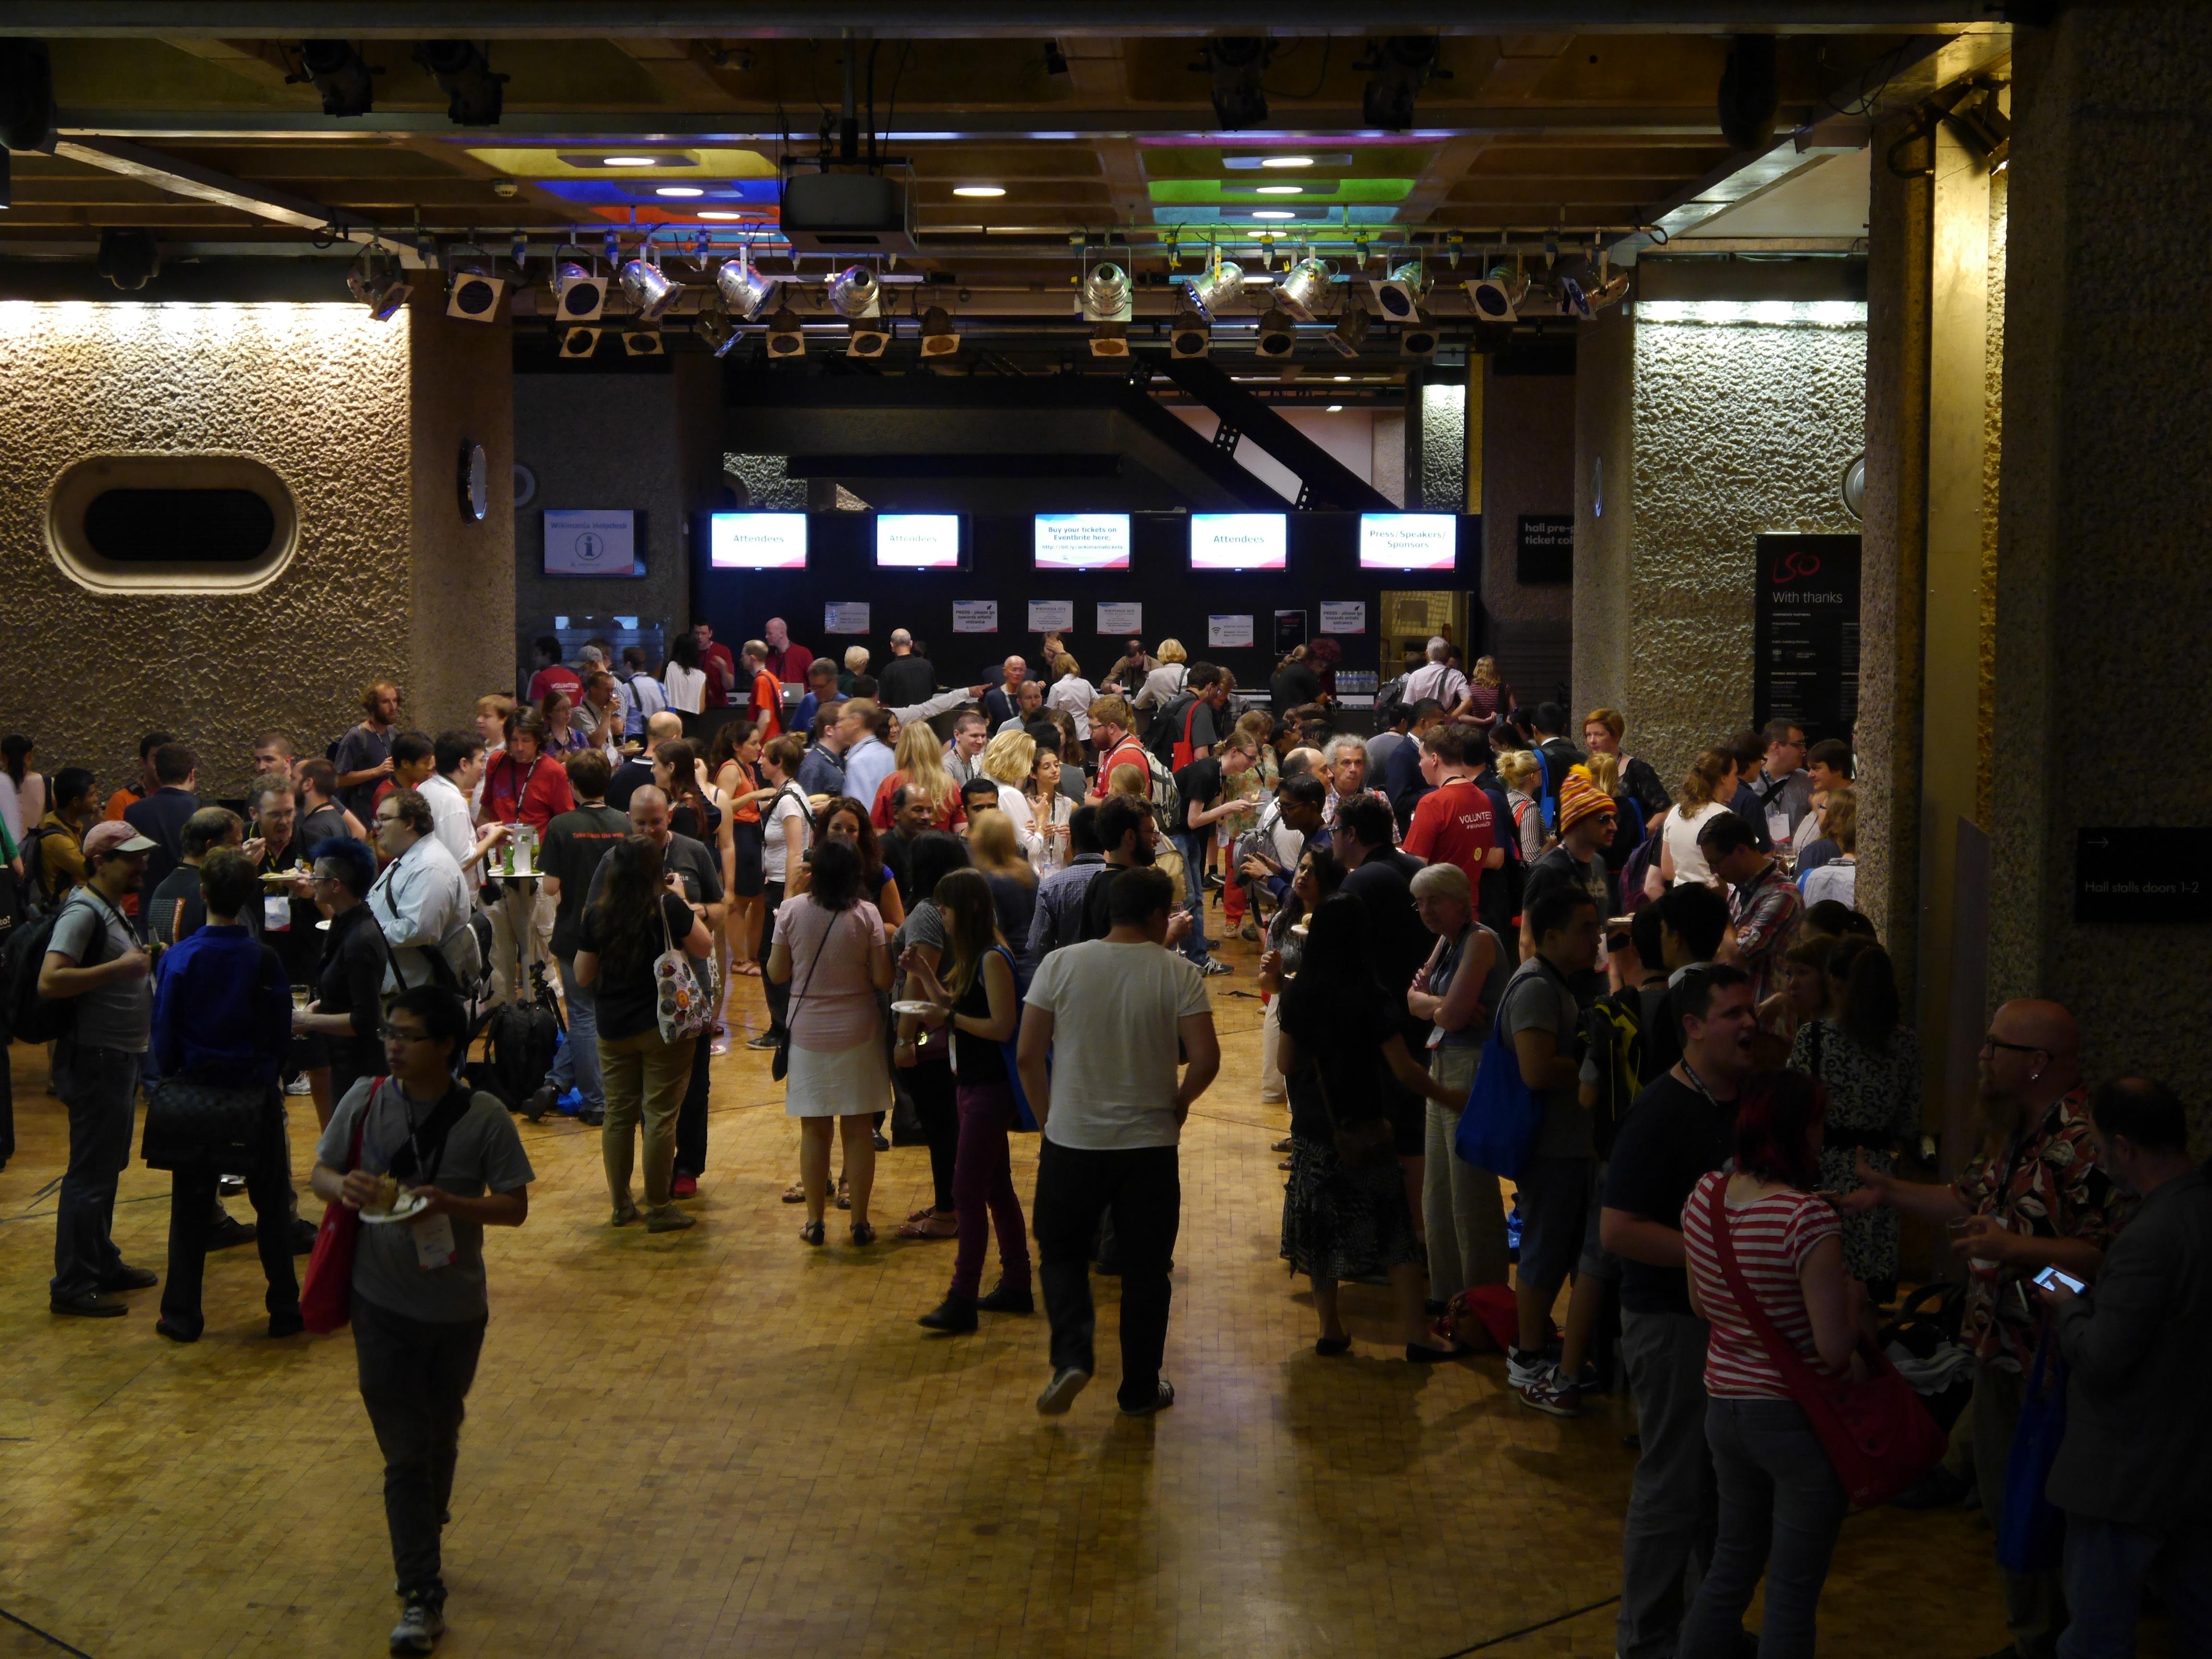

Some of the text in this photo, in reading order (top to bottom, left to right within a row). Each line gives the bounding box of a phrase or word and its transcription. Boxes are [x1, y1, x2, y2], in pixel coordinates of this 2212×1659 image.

[1525, 522, 1545, 532] hall
[1213, 535, 1264, 543] Attendees
[1525, 535, 1555, 544] ticket
[1387, 541, 1429, 549] Sponsors
[1772, 591, 1843, 603] With thanks
[2085, 881, 2109, 893] Hall
[2112, 881, 2140, 893] stalls
[2142, 881, 2177, 893] doors
